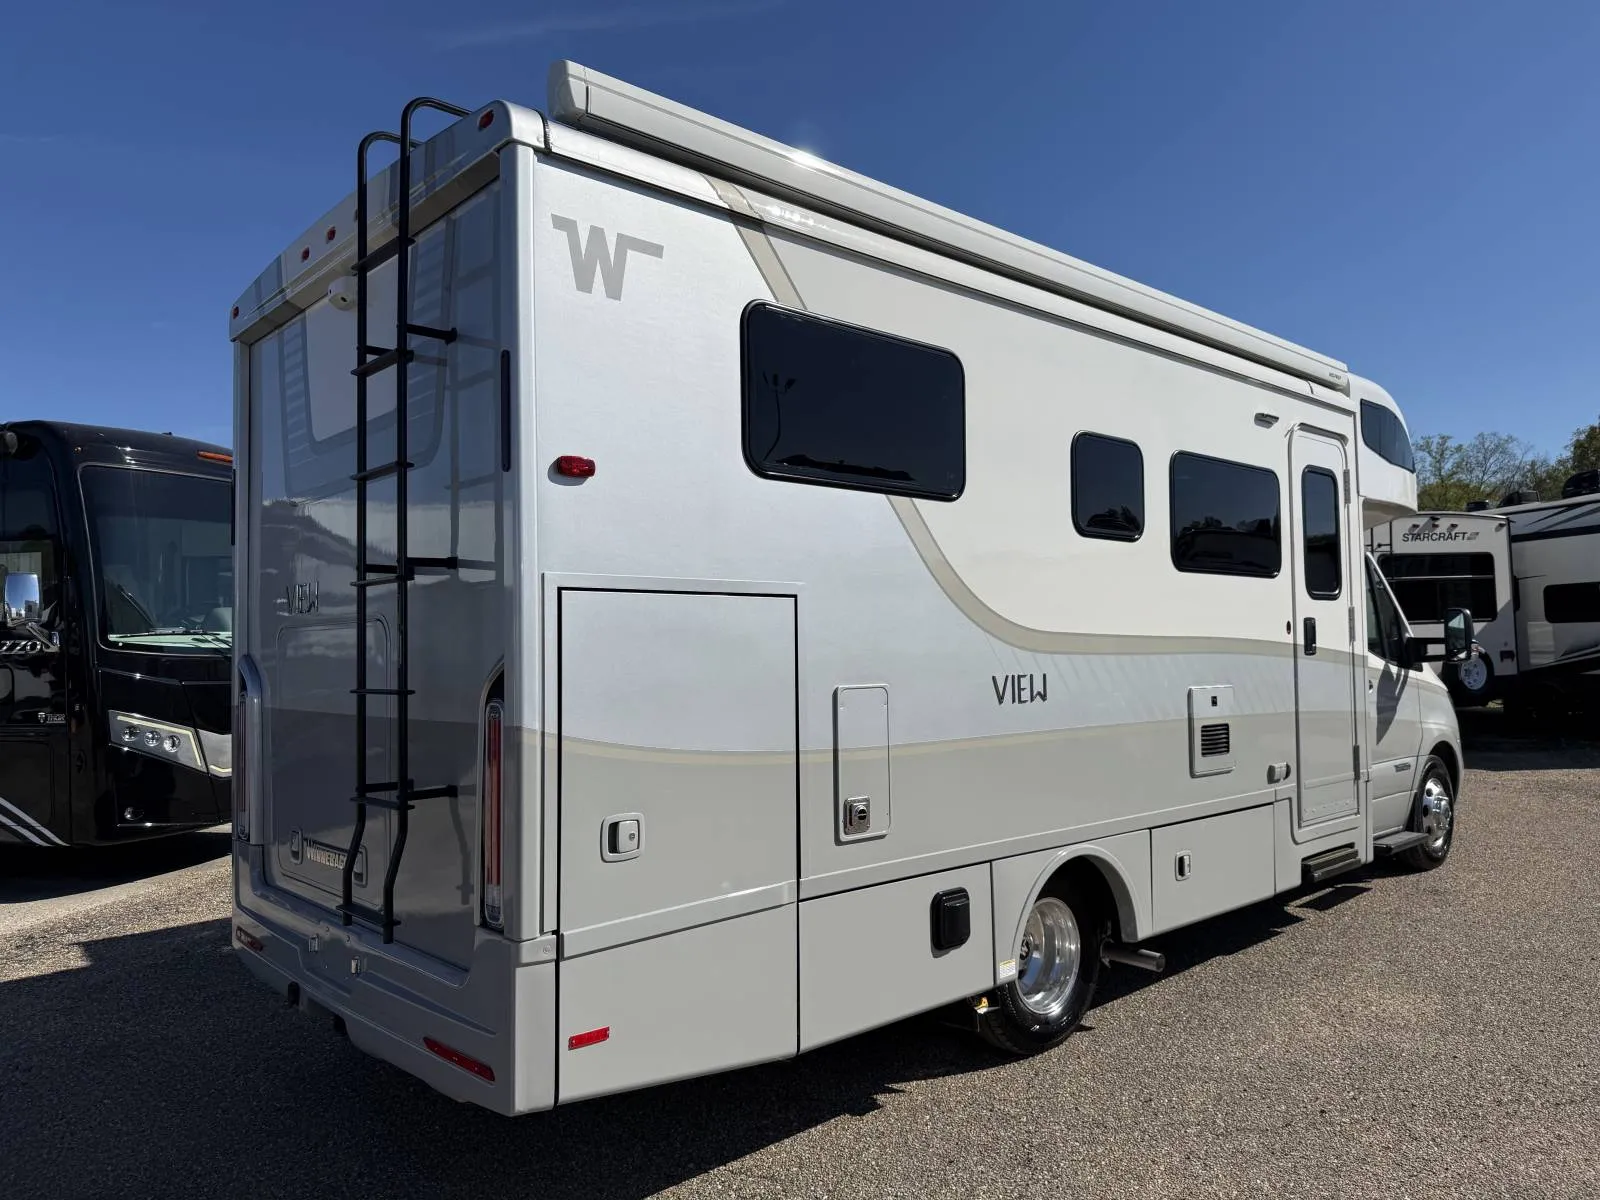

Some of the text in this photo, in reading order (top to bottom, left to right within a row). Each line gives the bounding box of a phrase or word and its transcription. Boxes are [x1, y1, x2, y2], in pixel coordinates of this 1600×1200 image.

[551, 212, 664, 302] W
[1402, 531, 1468, 543] STARCRAFT
[286, 581, 319, 614] VIEW
[992, 673, 1047, 705] VIEW
[306, 846, 347, 870] WINNEBAG
